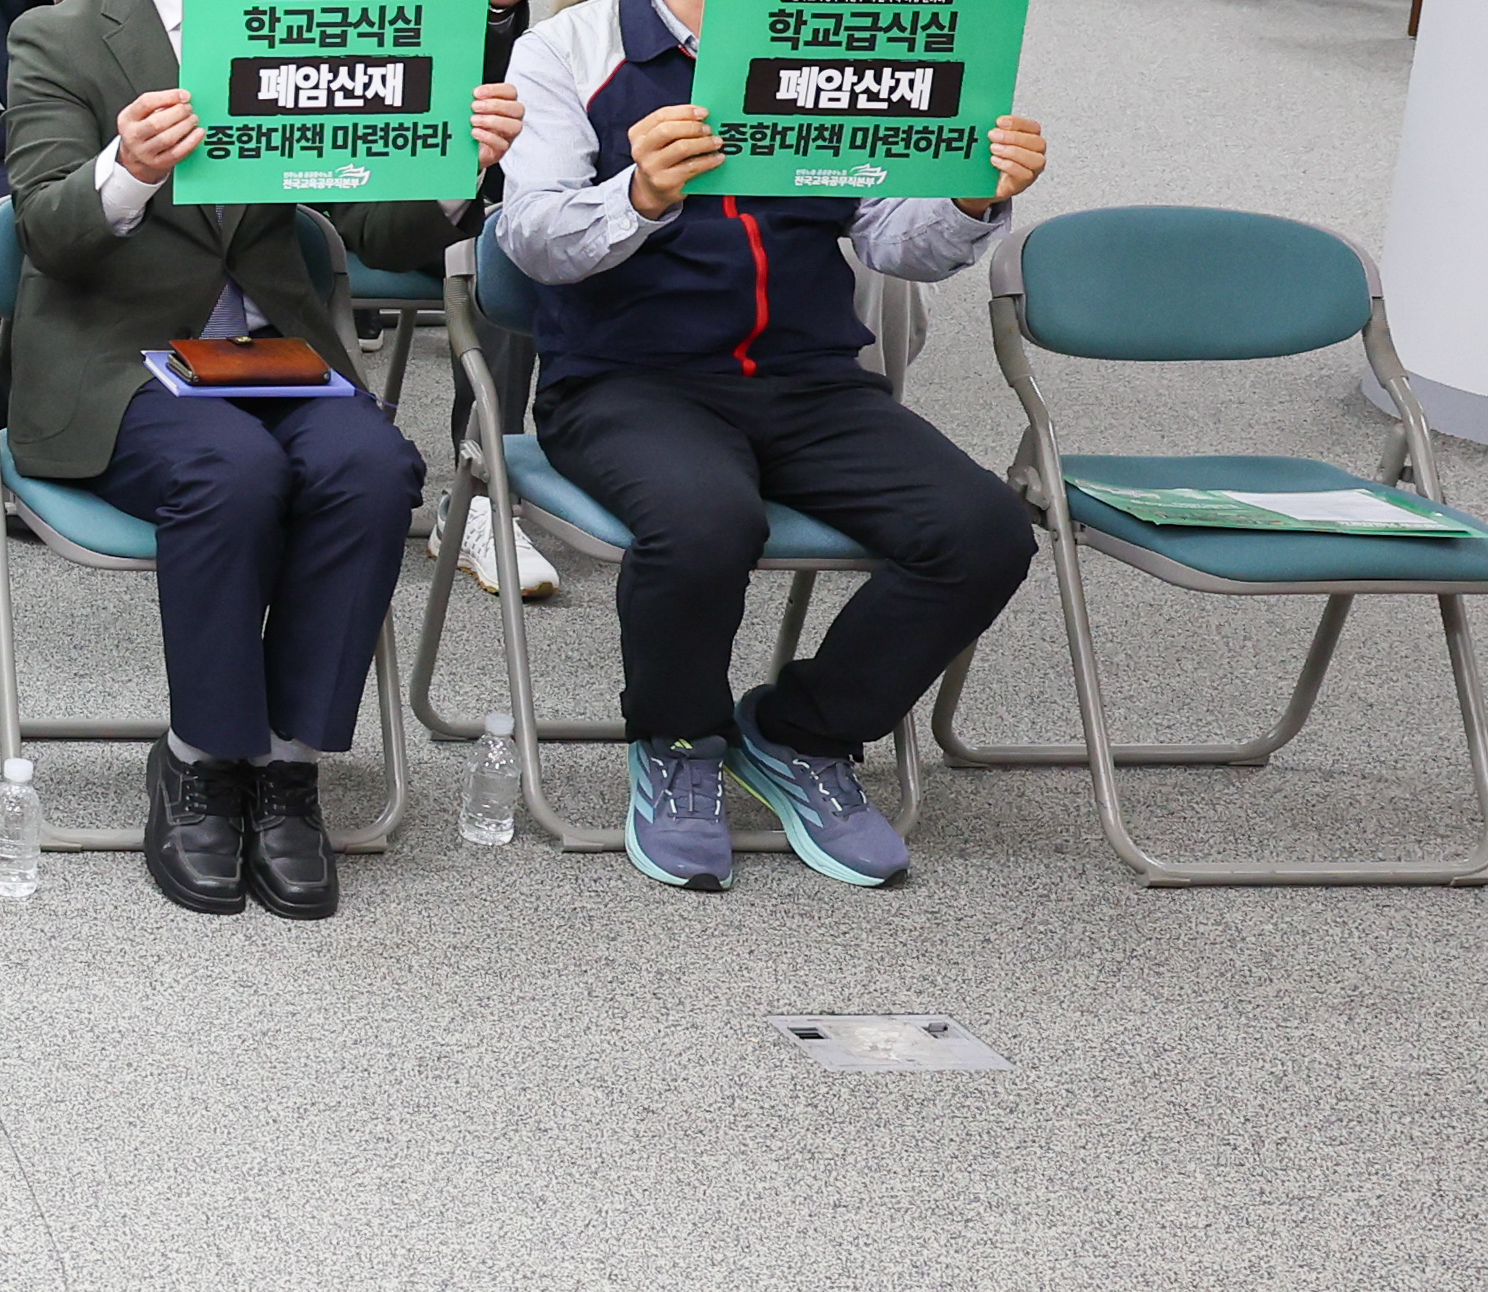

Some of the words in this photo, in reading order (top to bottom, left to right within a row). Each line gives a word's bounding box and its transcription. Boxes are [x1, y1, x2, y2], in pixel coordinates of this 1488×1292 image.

[243, 4, 422, 49] 학교급식실
[768, 8, 959, 52] 학교급식실
[257, 62, 404, 108] 폐암산재
[776, 66, 934, 110] 폐암산재
[203, 122, 324, 159] 종합대책
[331, 121, 452, 157] 마련하라
[715, 122, 843, 157] 종합대책
[848, 124, 978, 159] 마련하라
